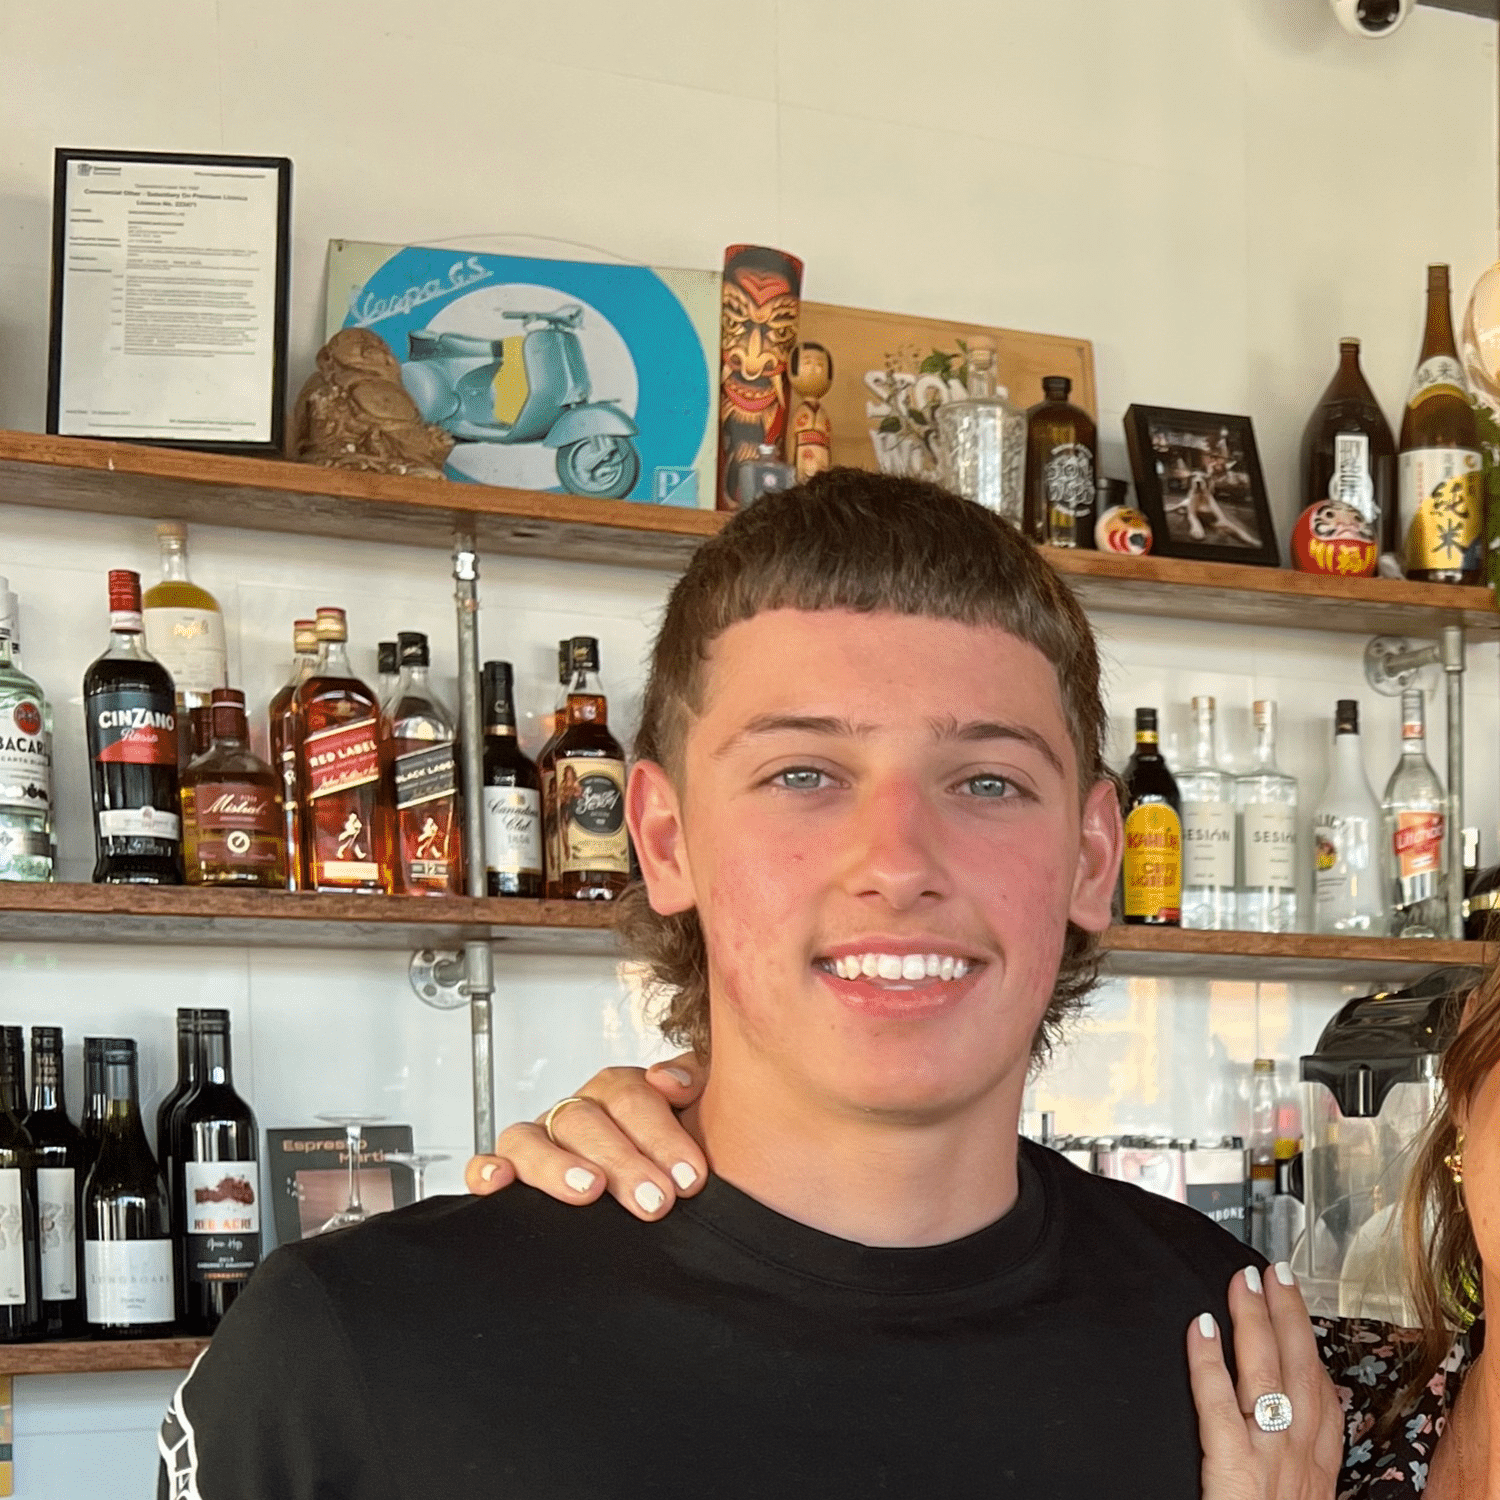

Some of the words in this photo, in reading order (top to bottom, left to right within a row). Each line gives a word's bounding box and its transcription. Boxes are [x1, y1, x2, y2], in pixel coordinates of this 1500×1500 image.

[349, 278, 450, 322] Vespa
[448, 256, 491, 285] GS
[659, 470, 681, 497] P
[98, 707, 175, 732] CINZANO
[308, 752, 336, 768] RED
[337, 740, 378, 759] LABEL
[202, 793, 269, 815] Mistral
[1184, 828, 1231, 843] ESIÓN
[423, 862, 436, 876] 12
[282, 1138, 368, 1153] Espreso
